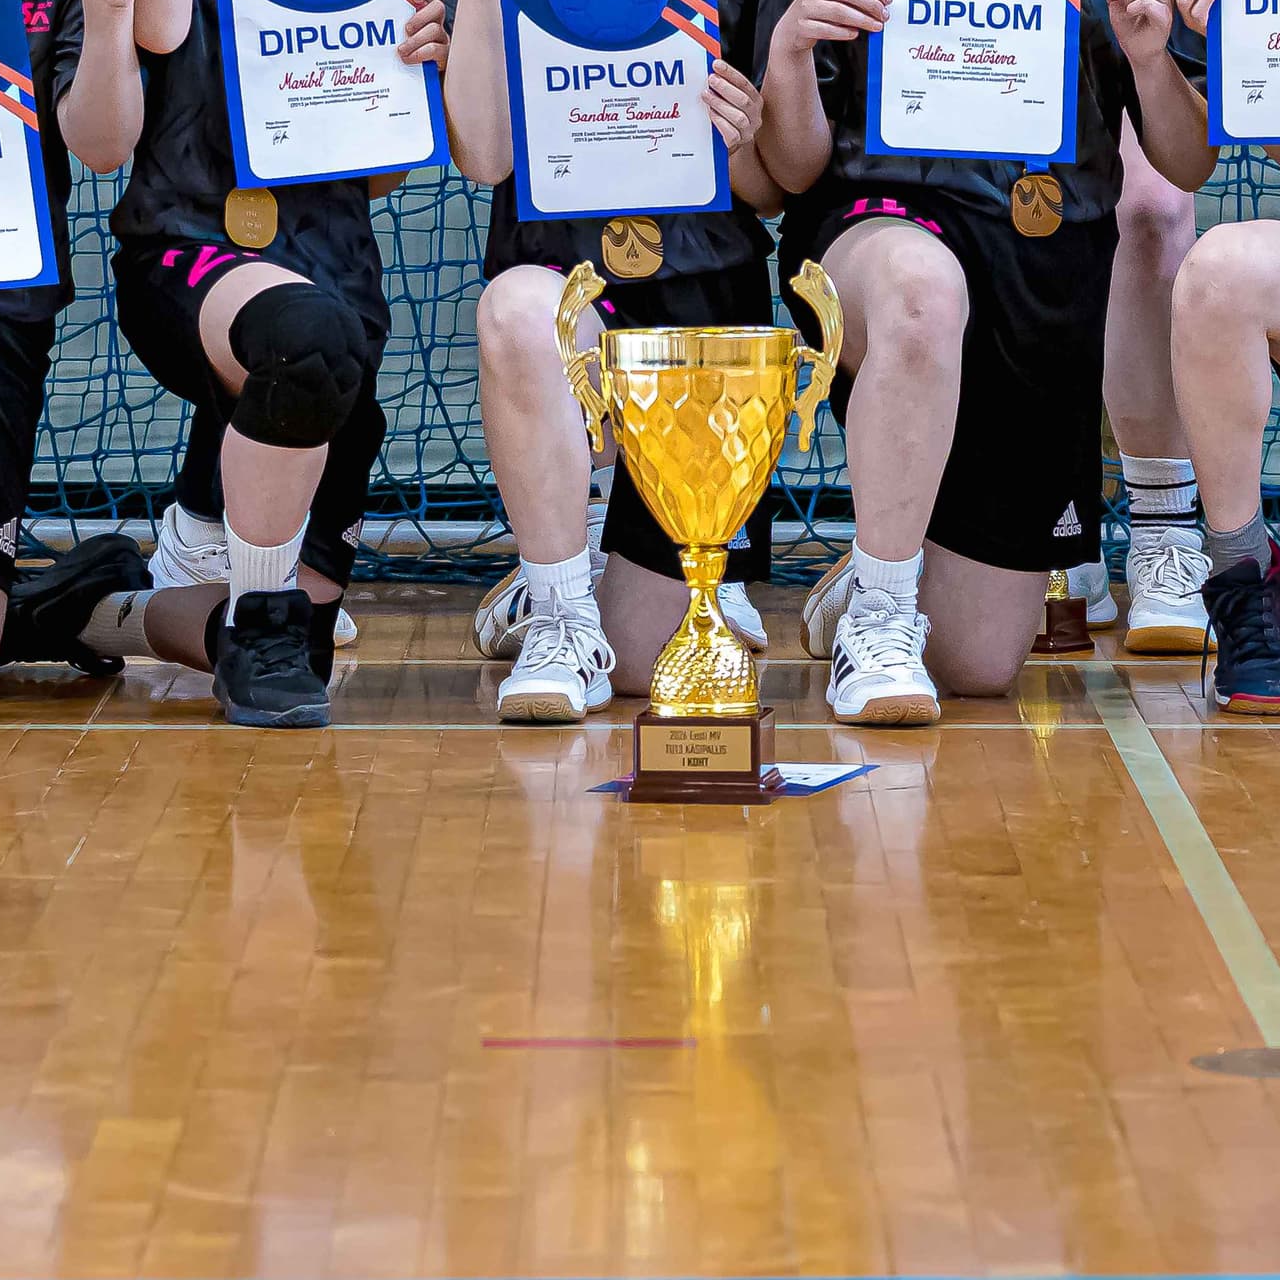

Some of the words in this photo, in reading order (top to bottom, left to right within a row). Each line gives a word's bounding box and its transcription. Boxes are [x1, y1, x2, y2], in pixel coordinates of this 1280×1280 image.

[907, 0, 1042, 30] DIPLOM
[259, 19, 396, 56] DIPLOM
[909, 45, 956, 62] Adelina
[331, 67, 375, 86] Varblas
[546, 60, 684, 92] DIPLOM
[569, 104, 620, 123] Sandra
[625, 102, 681, 120] Saviauk
[1053, 524, 1081, 537] adidas
[709, 731, 722, 740] MV
[687, 757, 709, 767] KOHT
